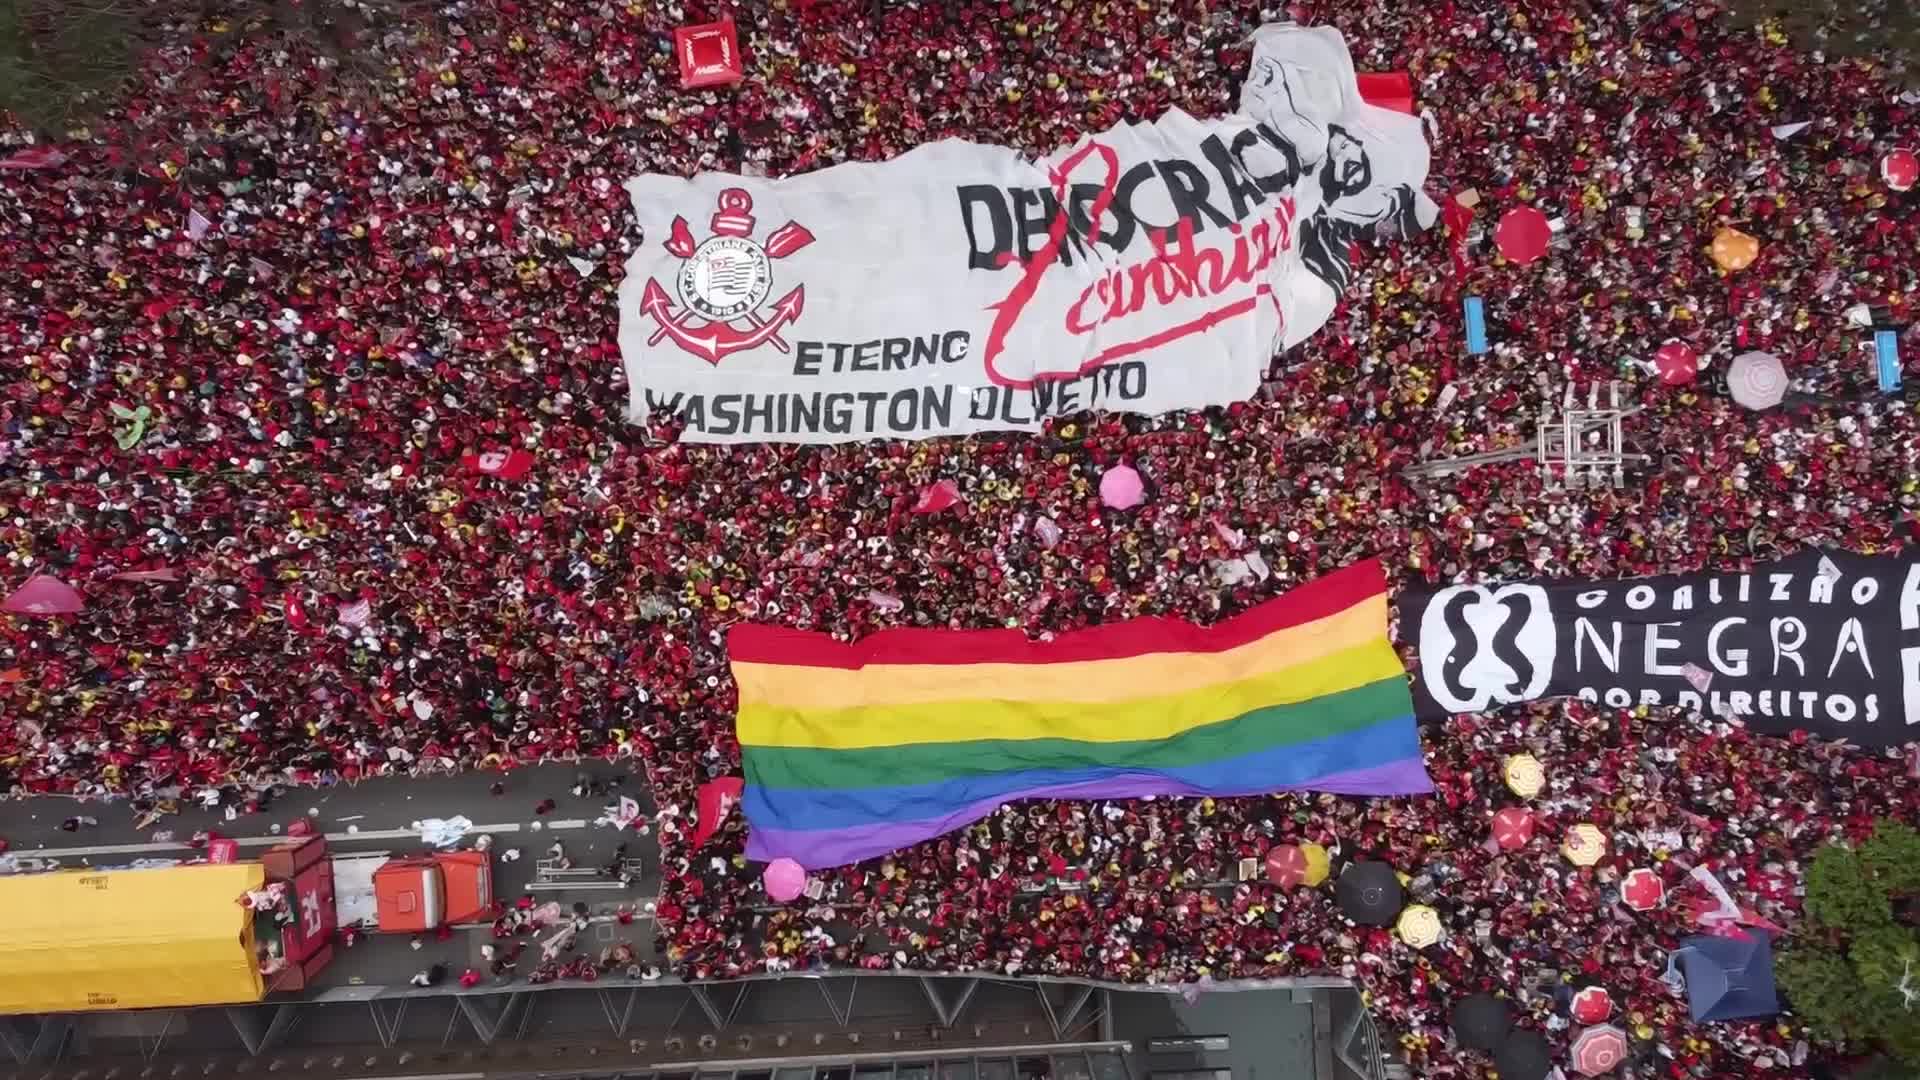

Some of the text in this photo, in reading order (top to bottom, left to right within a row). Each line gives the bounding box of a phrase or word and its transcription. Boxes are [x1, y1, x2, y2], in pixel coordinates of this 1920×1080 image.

[645, 384, 952, 435] WASHINGTON
[1574, 616, 1875, 680] NEGRA
[1678, 690, 1879, 723] DIREITOS
